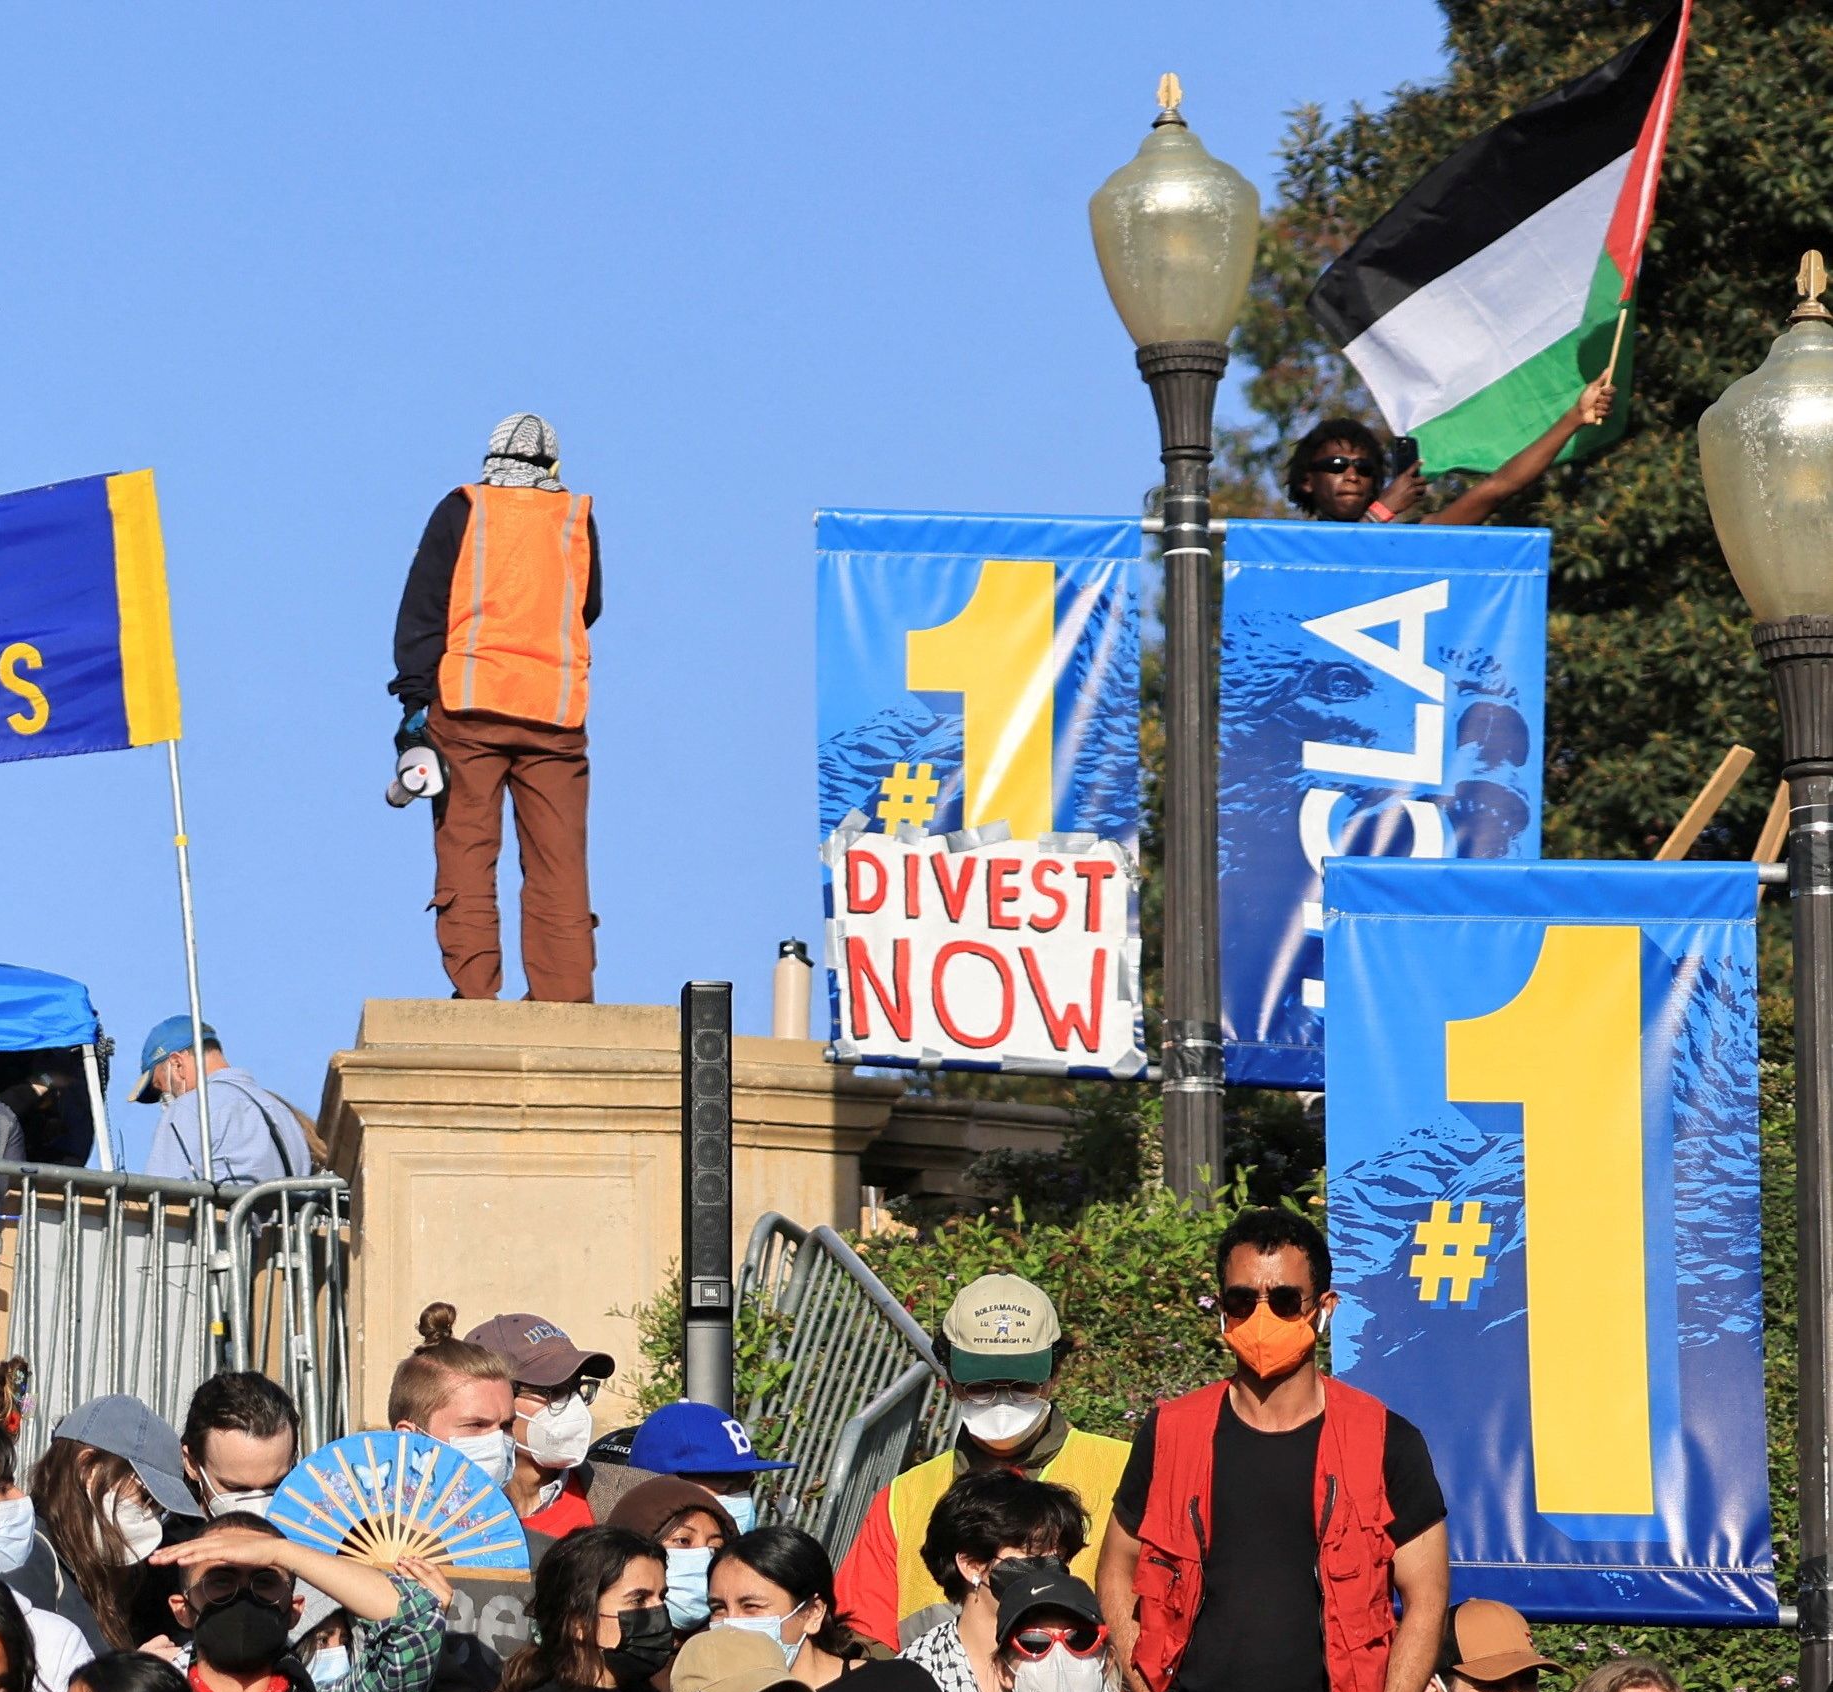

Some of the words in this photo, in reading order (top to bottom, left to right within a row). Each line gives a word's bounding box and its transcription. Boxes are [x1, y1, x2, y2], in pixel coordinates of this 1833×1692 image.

[846, 850, 1117, 934] DIVEST
[846, 935, 1108, 1053] NOW
[704, 1288, 718, 1297] JBL
[974, 1303, 1031, 1318] BOILERMAKERS
[721, 1419, 752, 1455] B
